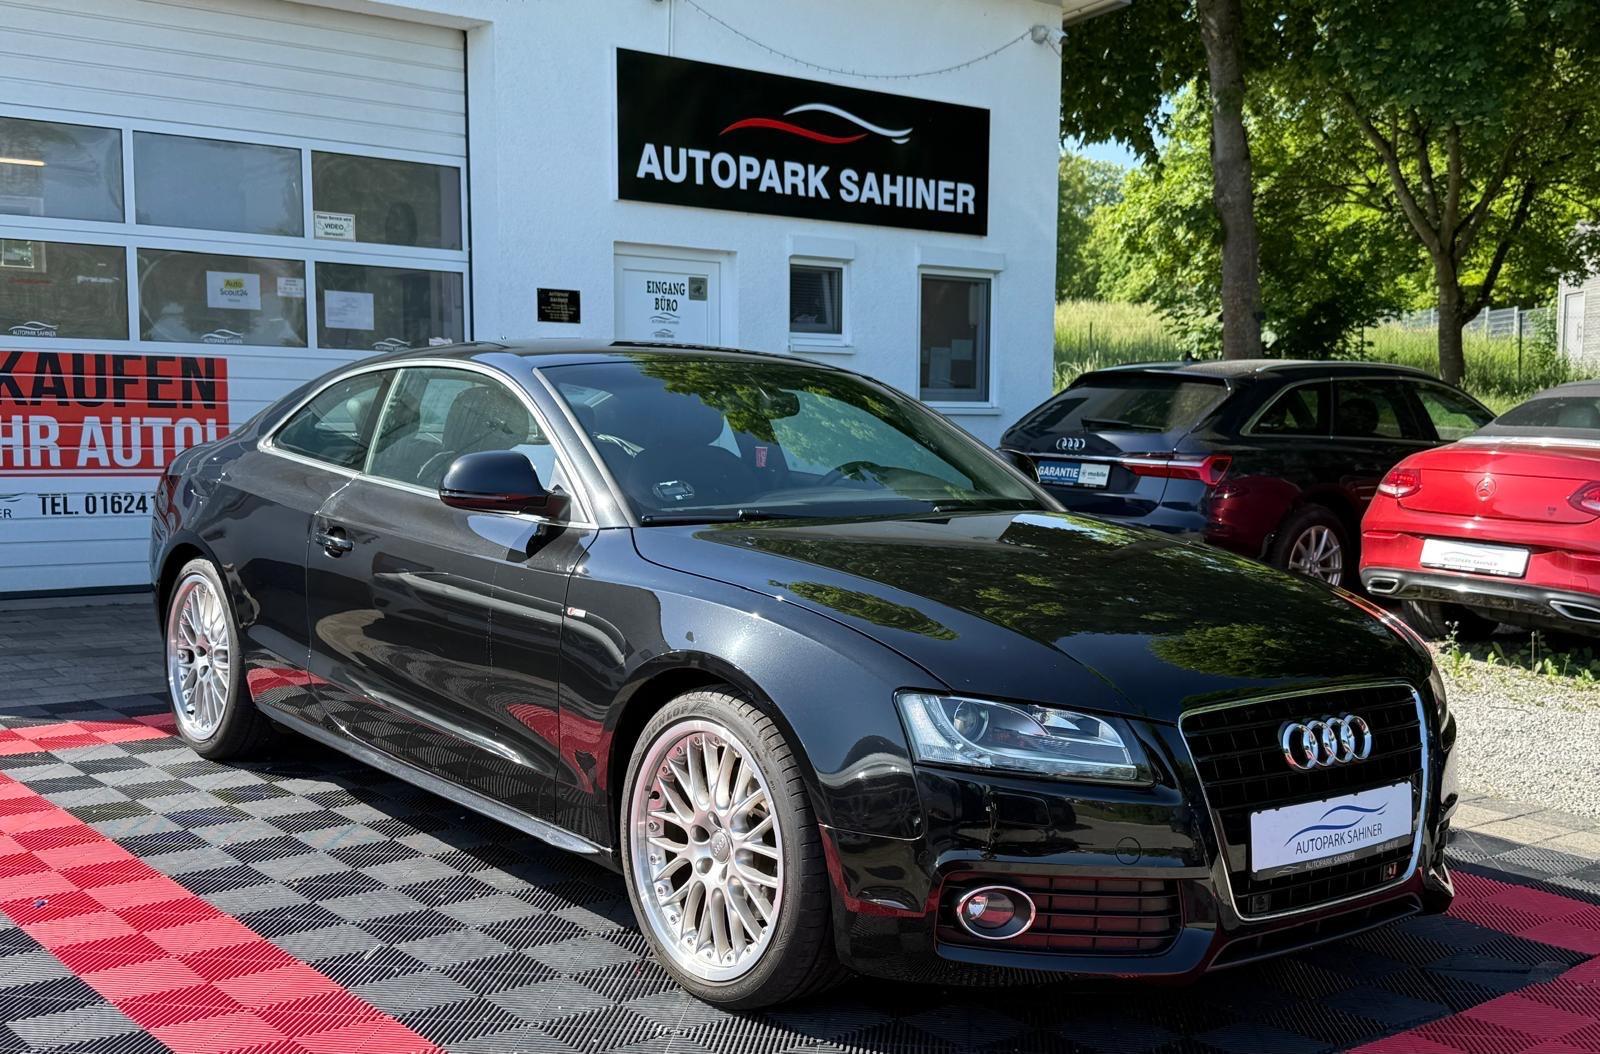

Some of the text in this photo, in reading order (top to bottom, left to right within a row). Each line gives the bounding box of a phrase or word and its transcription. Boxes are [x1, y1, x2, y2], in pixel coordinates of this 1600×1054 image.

[636, 143, 976, 215] AUTOPARK SAHINER
[225, 279, 243, 287] Auto
[646, 280, 686, 296] EINGANG
[219, 287, 248, 297] Scout24
[654, 295, 678, 312] BÜRO
[0, 351, 217, 410] KAUFEN
[1038, 465, 1080, 478] GARANTIE
[37, 493, 79, 515] TEL.
[1295, 822, 1383, 855] AUTOPARK SAHINER
